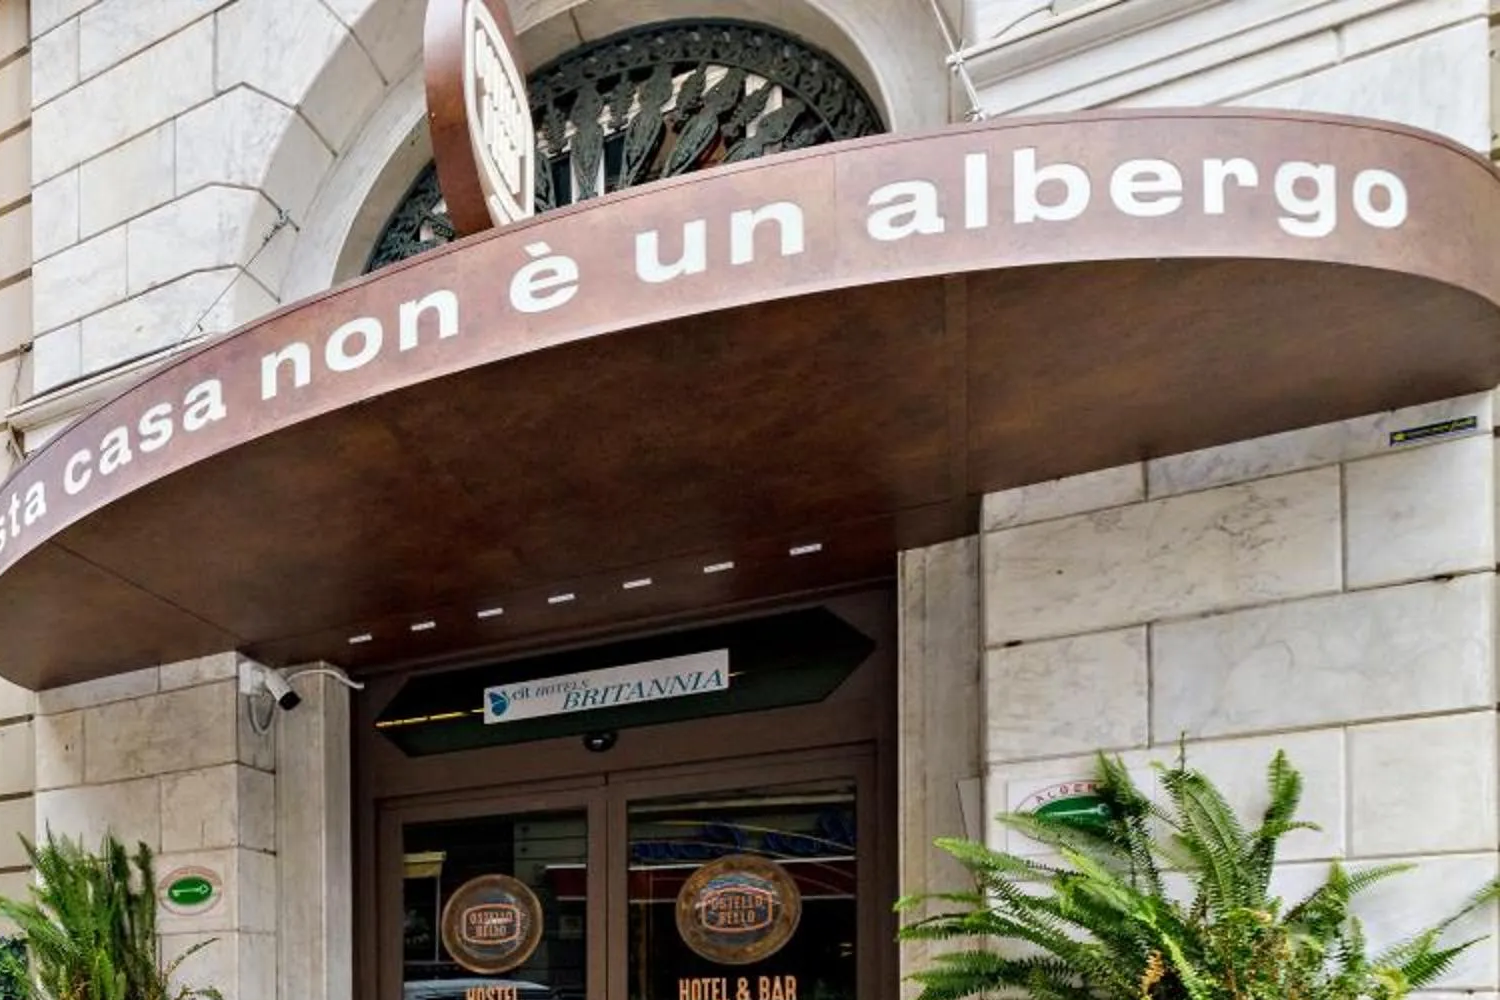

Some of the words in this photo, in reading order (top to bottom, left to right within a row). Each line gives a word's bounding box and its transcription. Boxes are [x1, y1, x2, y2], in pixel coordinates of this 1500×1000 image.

[63, 378, 228, 496] casa
[260, 288, 460, 401] non
[508, 240, 601, 314] è
[634, 199, 805, 284] un
[866, 147, 1409, 241] albergo
[562, 668, 723, 711] BRITANNIA
